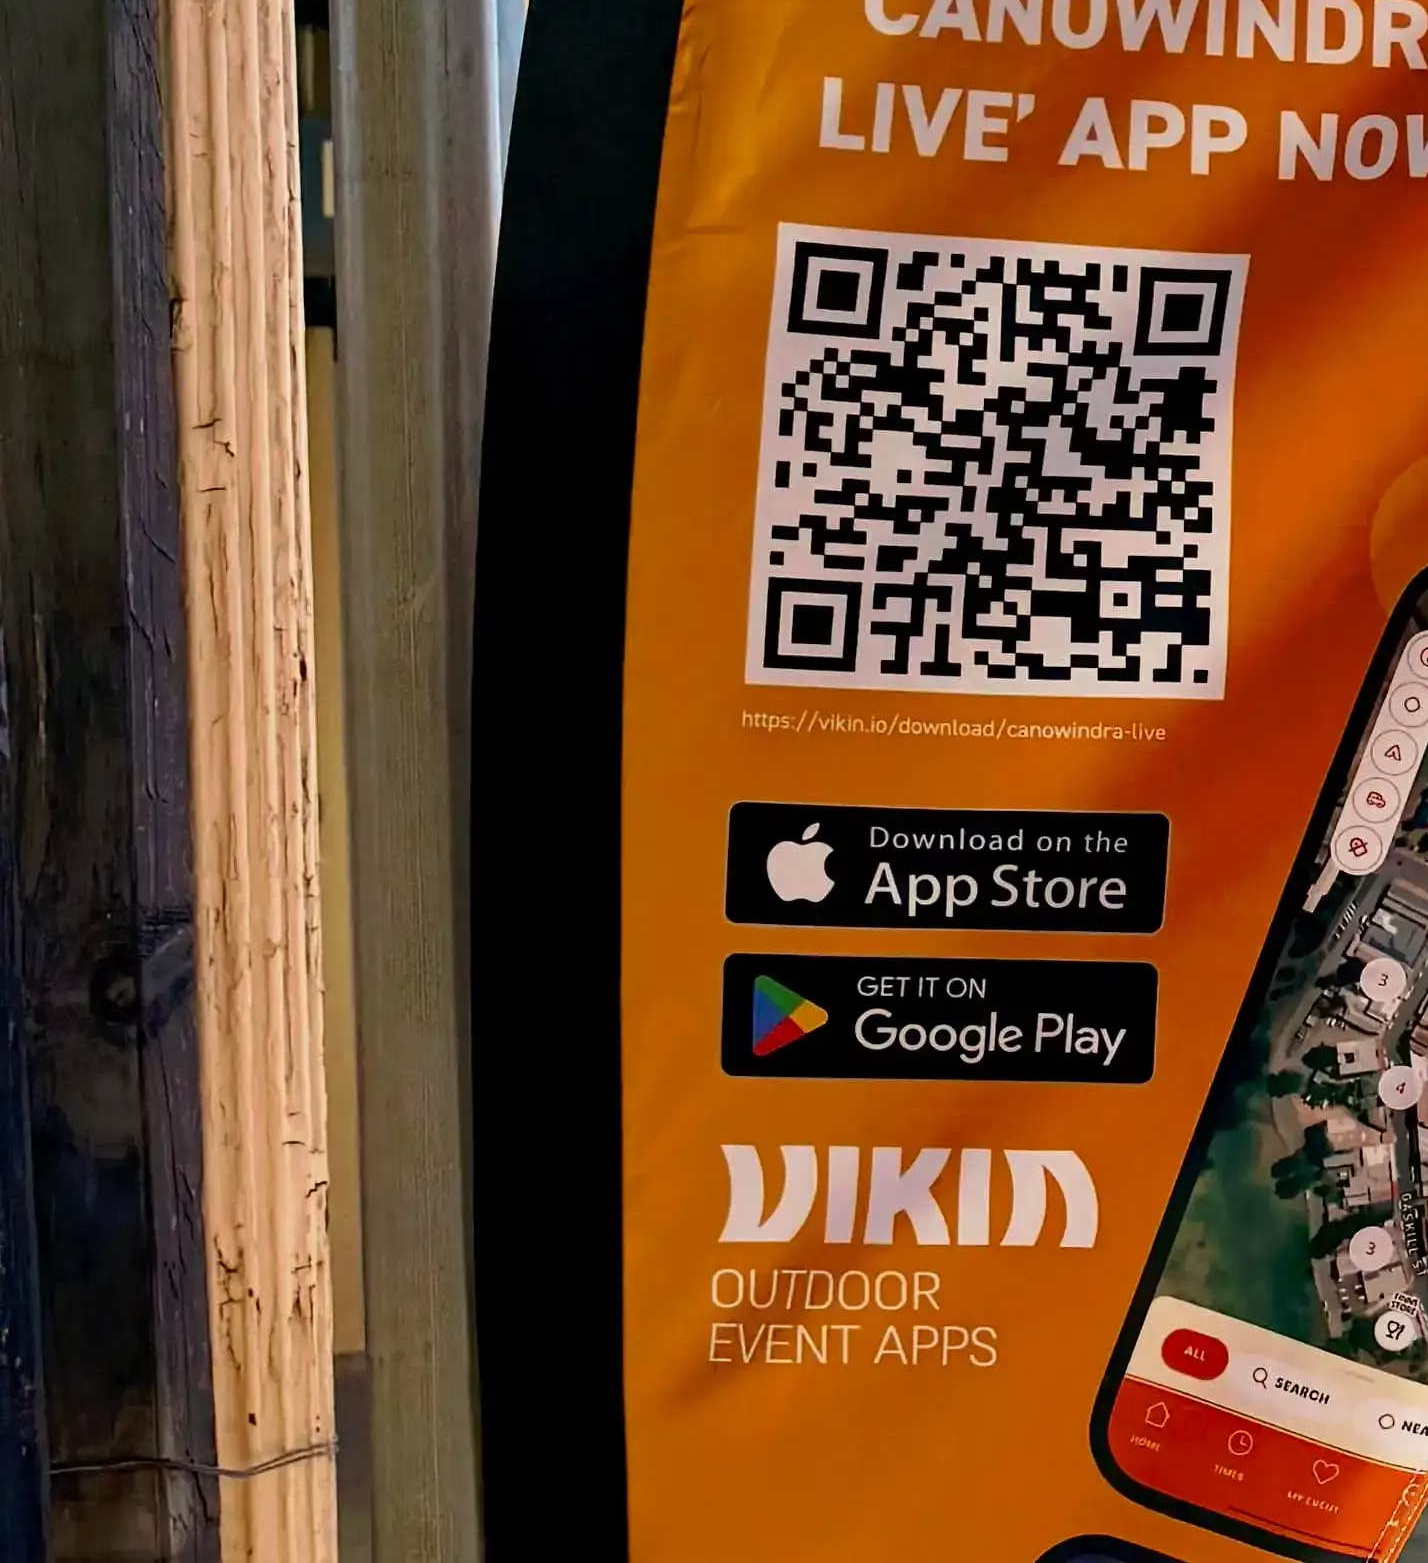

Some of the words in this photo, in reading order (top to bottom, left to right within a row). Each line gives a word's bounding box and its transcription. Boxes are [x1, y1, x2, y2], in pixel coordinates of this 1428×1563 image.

[1059, 96, 1248, 177] APP
[741, 709, 1168, 742] https://vikin.io/download/canowindra-live
[869, 825, 1024, 853] Download
[1036, 835, 1072, 853] on
[1084, 830, 1129, 854] the
[864, 861, 979, 918] App
[990, 864, 1128, 910] Store
[856, 976, 911, 998] GET
[918, 977, 940, 998] IT
[945, 977, 987, 999] ON
[1378, 973, 1389, 988] 3
[854, 1007, 1023, 1064] Google
[1034, 1012, 1127, 1066] Play
[718, 1143, 1099, 1249] VIKIN
[1364, 1241, 1377, 1256] 3
[1401, 1192, 1419, 1255] GASKILL
[1412, 1260, 1428, 1277] ST
[711, 1268, 941, 1311] OUTDOOR
[708, 1322, 862, 1364] EVENT
[873, 1324, 998, 1367] APPS
[1183, 1345, 1207, 1362] ALL
[1274, 1376, 1331, 1406] SEARCH
